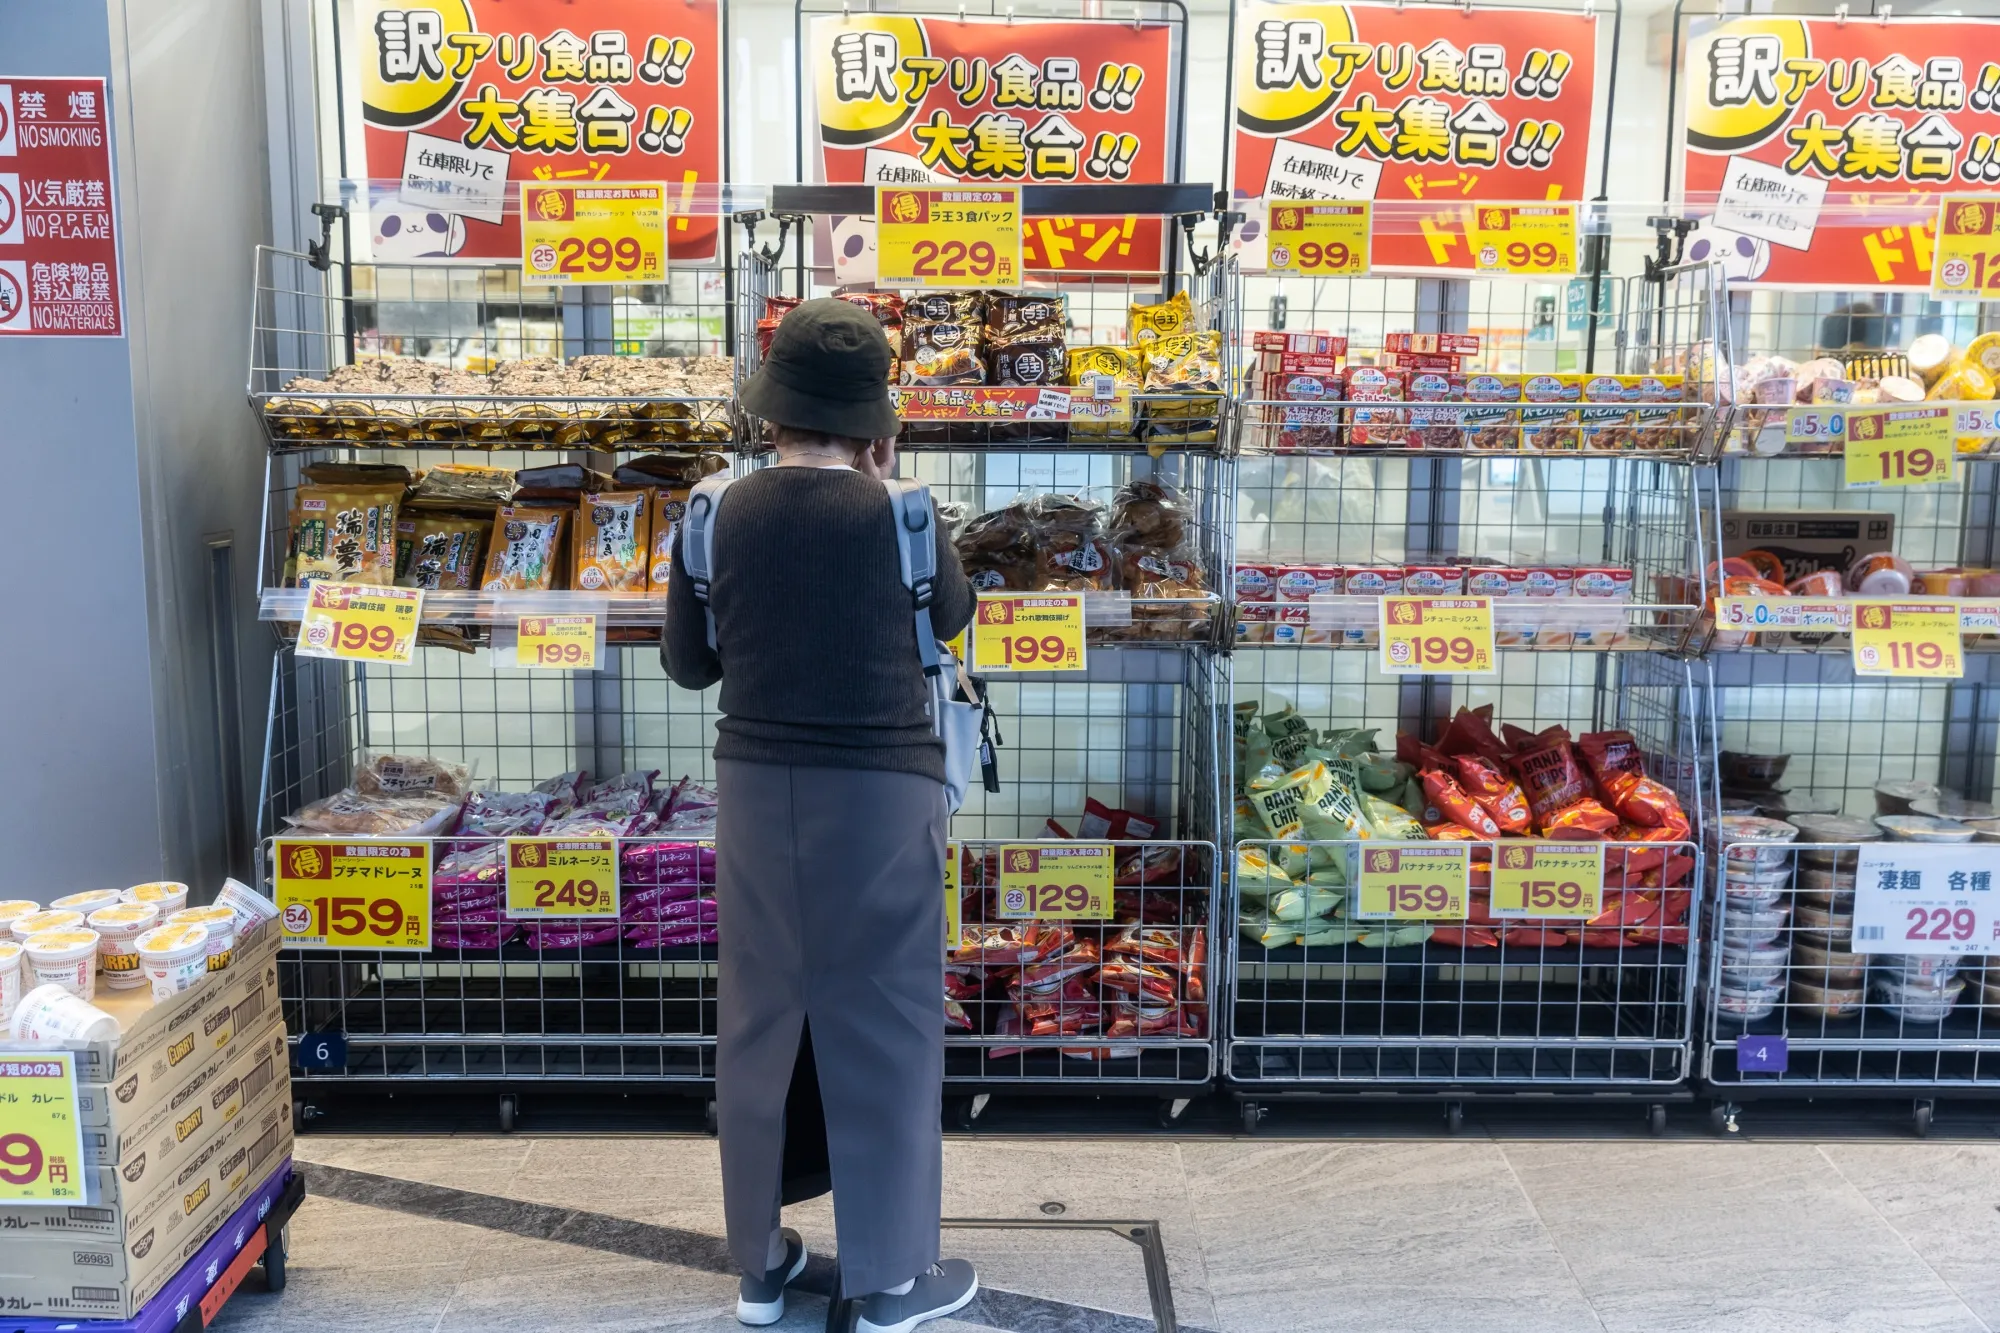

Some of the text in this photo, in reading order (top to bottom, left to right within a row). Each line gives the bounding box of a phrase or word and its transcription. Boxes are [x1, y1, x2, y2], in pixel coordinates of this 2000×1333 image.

[19, 91, 96, 119] 禁煙
[458, 85, 694, 155] 大集合!!
[19, 125, 101, 148] NO SMOKING
[1335, 94, 1564, 169] 大集合!!
[912, 109, 1140, 181] 大集合!!
[417, 149, 493, 181] 在庫限りで
[1283, 156, 1364, 189] 在庫限りで
[25, 179, 105, 208] 火気厳禁
[1404, 172, 1478, 199] ドーン
[942, 192, 1002, 202] 数量限定の為
[49, 213, 109, 227] OPEN
[930, 211, 1012, 222] ラ王3食パック
[26, 214, 45, 239] NO
[50, 226, 110, 239] FLAME
[534, 249, 554, 262] 25
[559, 237, 641, 272] 299
[912, 240, 995, 276] 229
[1273, 251, 1288, 259] 76
[1299, 242, 1349, 268] 99
[1350, 258, 1360, 267] 円
[1481, 250, 1496, 259] 75
[1506, 242, 1557, 267] 99
[644, 257, 656, 270] 円
[998, 262, 1011, 275] 円
[1945, 264, 1966, 276] 29
[32, 262, 109, 282] 危険物品
[33, 282, 111, 302] 持込厳禁
[33, 306, 51, 329] NO
[52, 304, 114, 318] HAZARDOUS
[927, 305, 948, 316] ラ王
[53, 317, 116, 330] MATERIALS
[1156, 315, 1176, 323] ラ王
[1019, 363, 1040, 373] ラ王
[1879, 448, 1934, 479] 119
[1936, 463, 1946, 473] 円
[309, 628, 326, 638] 26
[331, 621, 395, 652] 199
[536, 644, 582, 663] 199
[1002, 636, 1065, 663] 199
[1067, 651, 1076, 661] 円
[1391, 645, 1408, 655] 53
[1411, 637, 1474, 663] 199
[1863, 650, 1875, 659] 16
[1887, 642, 1943, 669] 119
[1476, 653, 1486, 663] 円
[1945, 658, 1955, 668] 円
[345, 846, 410, 857] 数量限定の為
[290, 846, 323, 878] 得
[548, 856, 610, 865] ミルネージュ
[1400, 863, 1461, 871] バナナチップス
[1534, 860, 1596, 868] バナナチップス
[334, 866, 422, 878] プチマドレーヌ
[1877, 870, 1992, 891] 凄麺 各種
[534, 880, 598, 907] 249
[600, 895, 610, 905] 円
[1007, 893, 1022, 903] 28
[1026, 884, 1089, 911] 129
[1387, 884, 1448, 911] 159
[1520, 881, 1582, 908] 159
[1090, 900, 1100, 910] 円
[1449, 900, 1459, 910] 円
[1583, 897, 1593, 907] 円
[286, 909, 307, 923] 54
[314, 897, 403, 936] 159
[1905, 908, 1975, 940] 229
[406, 922, 420, 935] 円
[168, 1032, 195, 1067] CURRY
[316, 1042, 329, 1060] 6
[1756, 1046, 1768, 1062] 4
[207, 1060, 224, 1076] カレー
[118, 1077, 137, 1099] NISSIN
[32, 1094, 65, 1104] カレー
[176, 1106, 203, 1143] CURRY
[215, 1133, 231, 1152] カレー
[0, 1133, 43, 1184] 9
[49, 1165, 68, 1183] 円
[125, 1157, 145, 1178] NISSIN
[184, 1178, 210, 1216] CURRY
[4, 1216, 40, 1229] カレー
[76, 1253, 110, 1264] 26983
[7, 1297, 43, 1310] カレー
